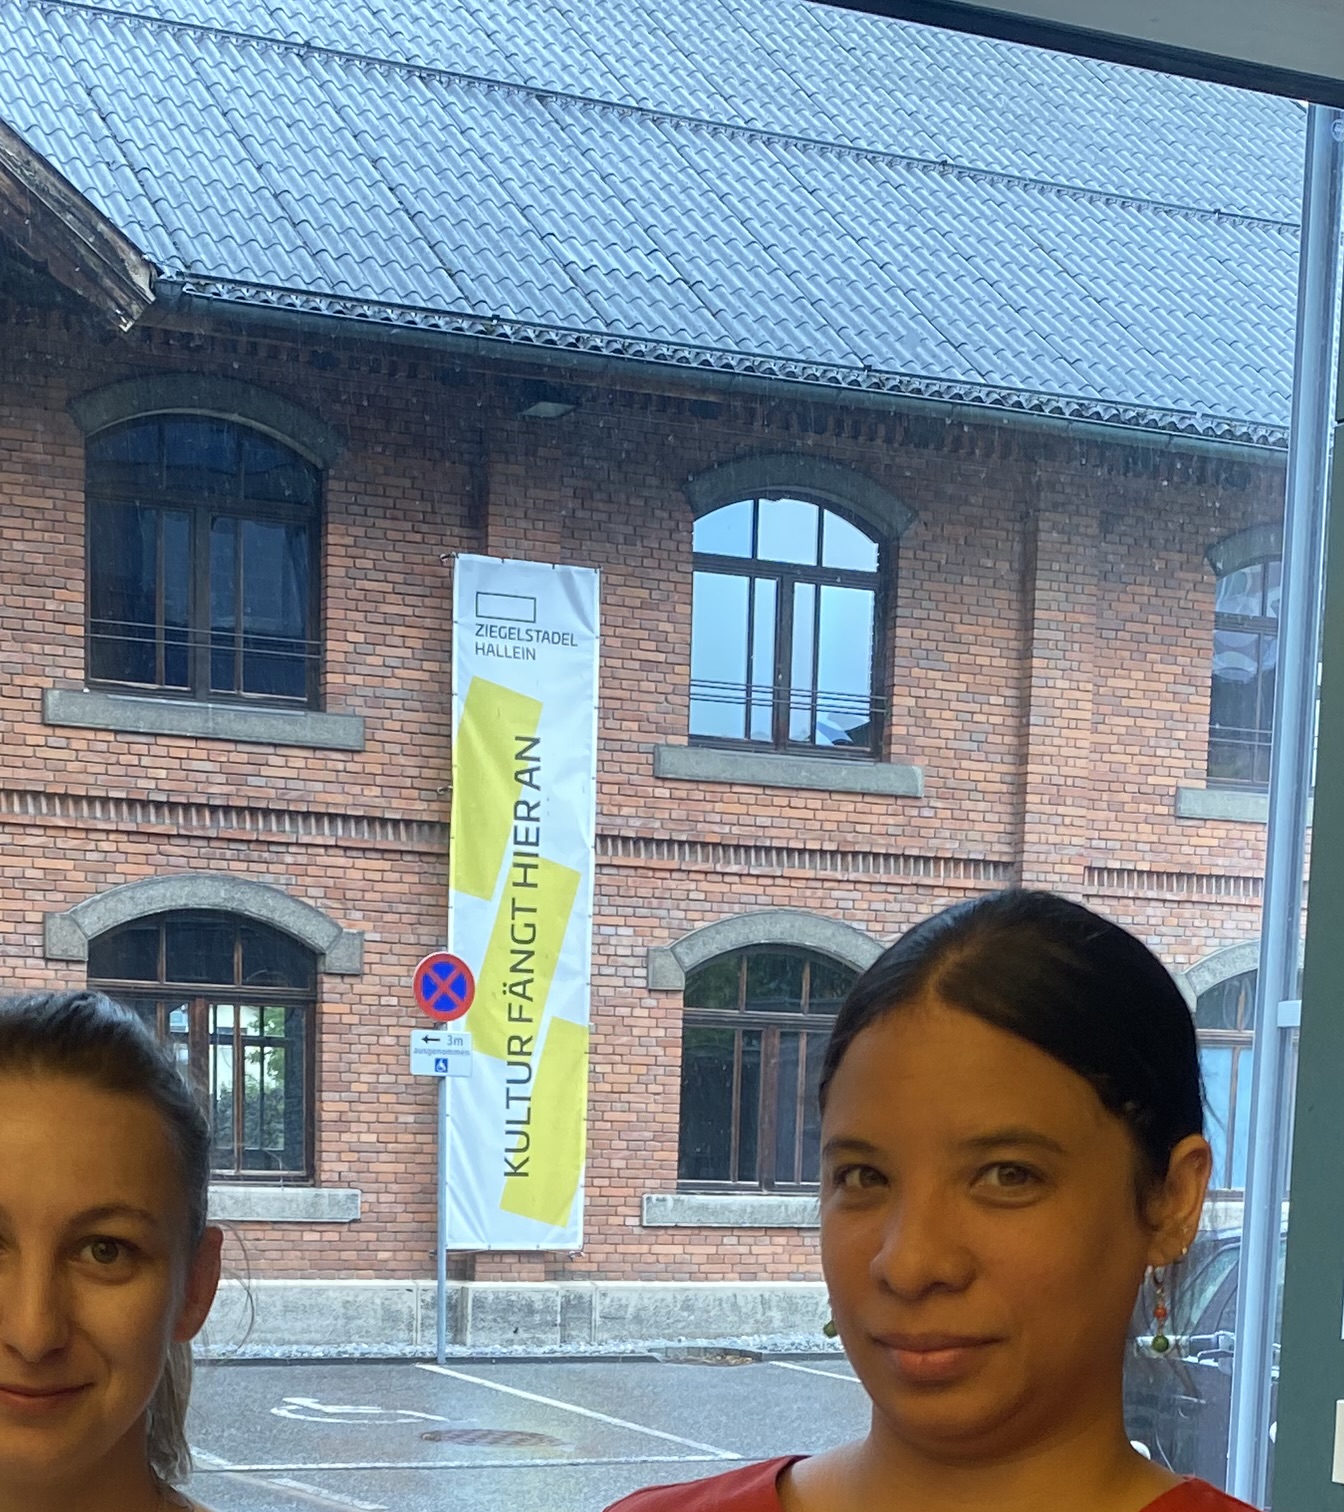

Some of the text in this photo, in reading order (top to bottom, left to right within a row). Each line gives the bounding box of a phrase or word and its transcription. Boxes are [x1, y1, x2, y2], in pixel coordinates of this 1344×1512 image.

[475, 623, 578, 647] ZIEGELSTADEL
[475, 641, 536, 661] HALLEIN
[502, 736, 542, 1177] KULTUR FÄNGT HIER AN
[447, 1034, 464, 1047] 3m
